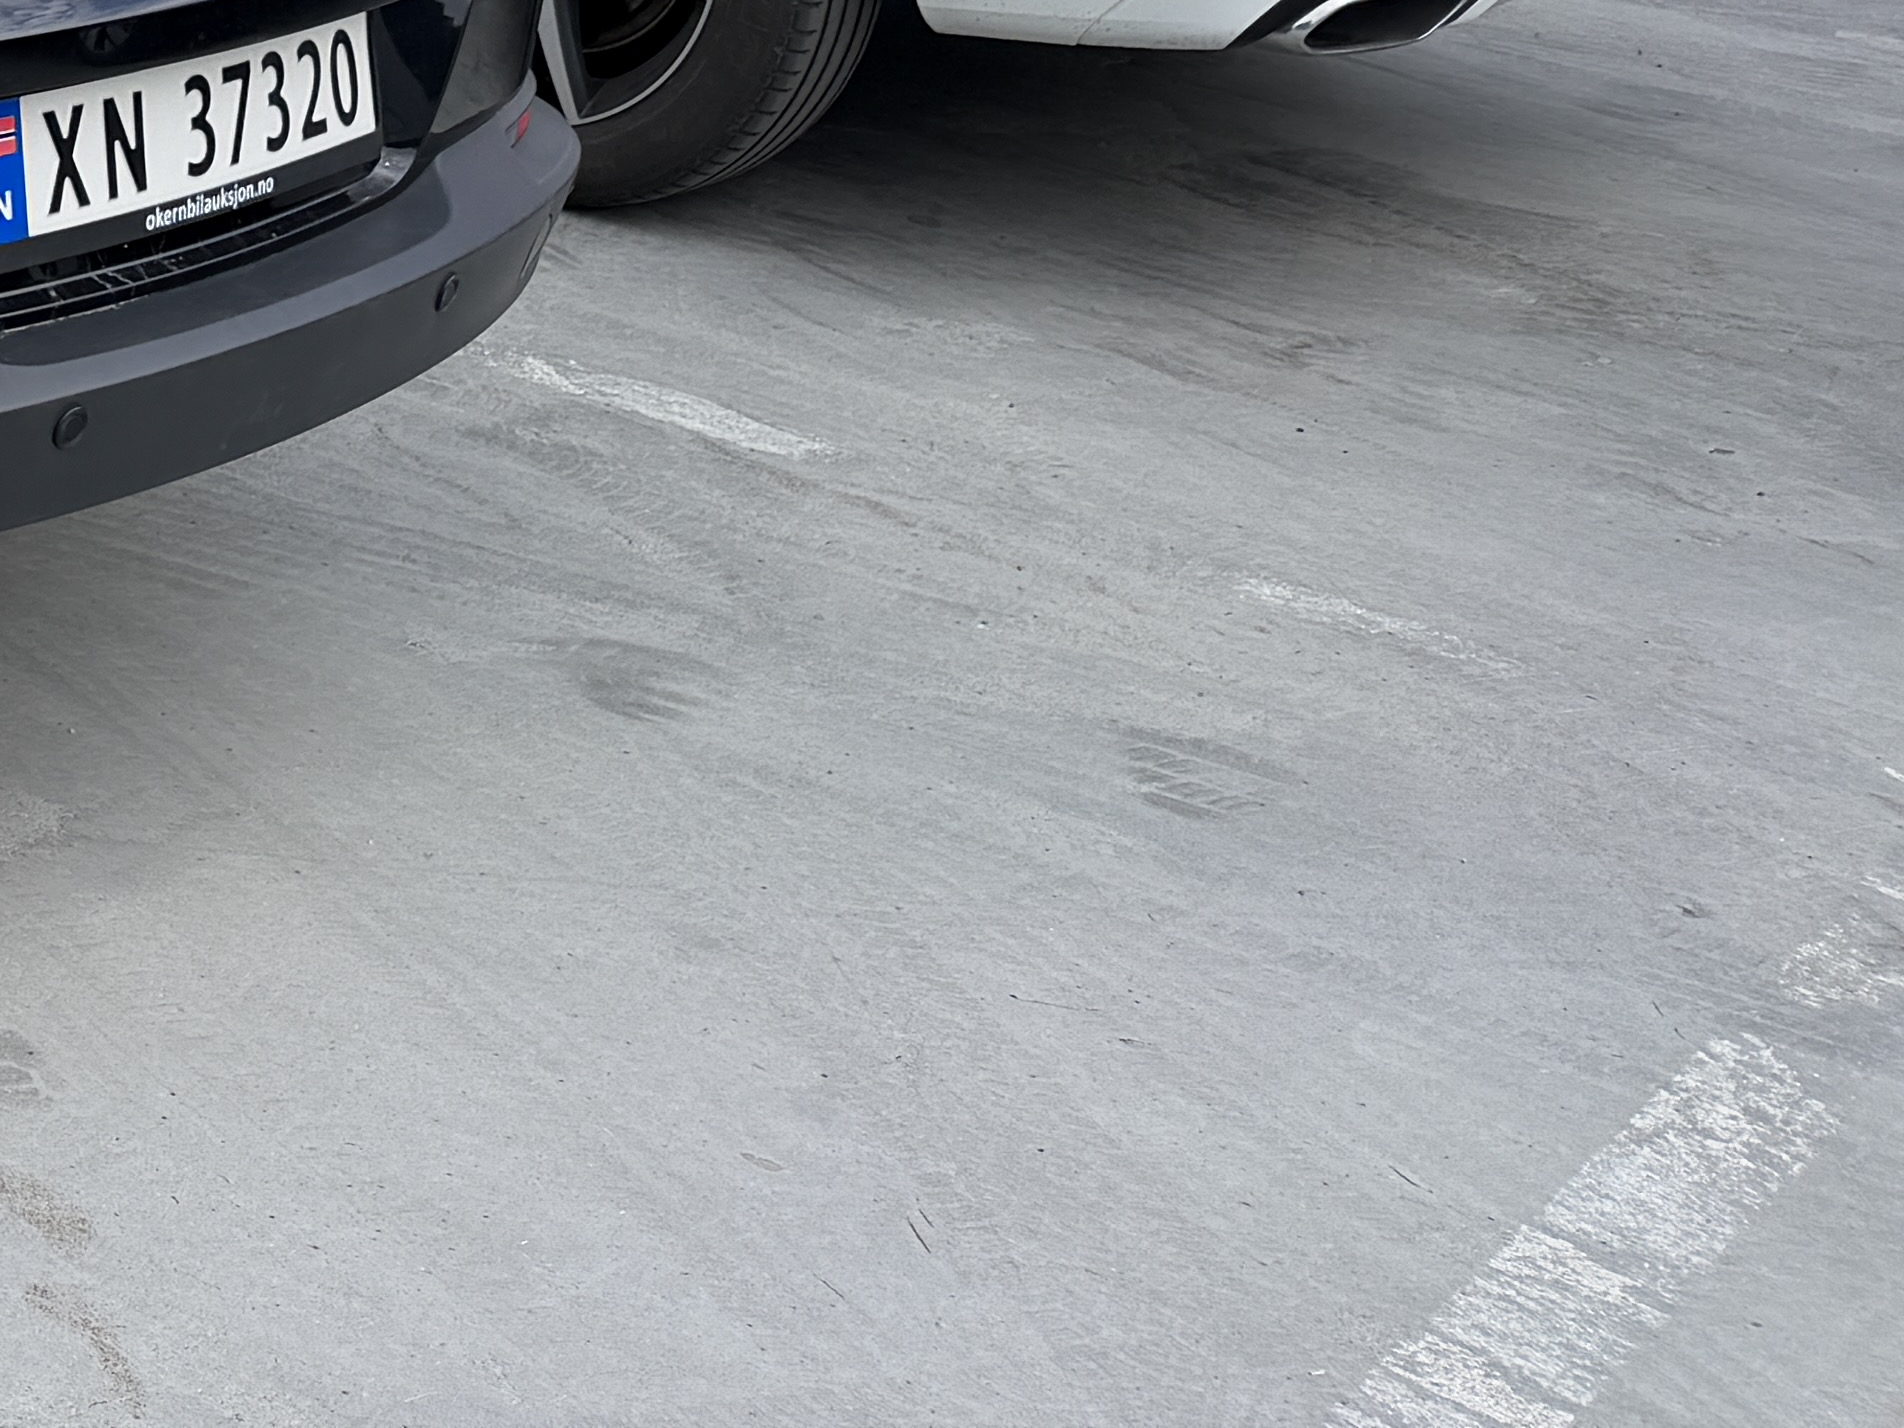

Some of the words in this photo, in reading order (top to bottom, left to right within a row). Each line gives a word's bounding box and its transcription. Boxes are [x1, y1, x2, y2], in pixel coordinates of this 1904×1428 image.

[42, 90, 148, 217] XN
[184, 28, 359, 178] 37320
[145, 175, 275, 232] okernbilauksjon.no
